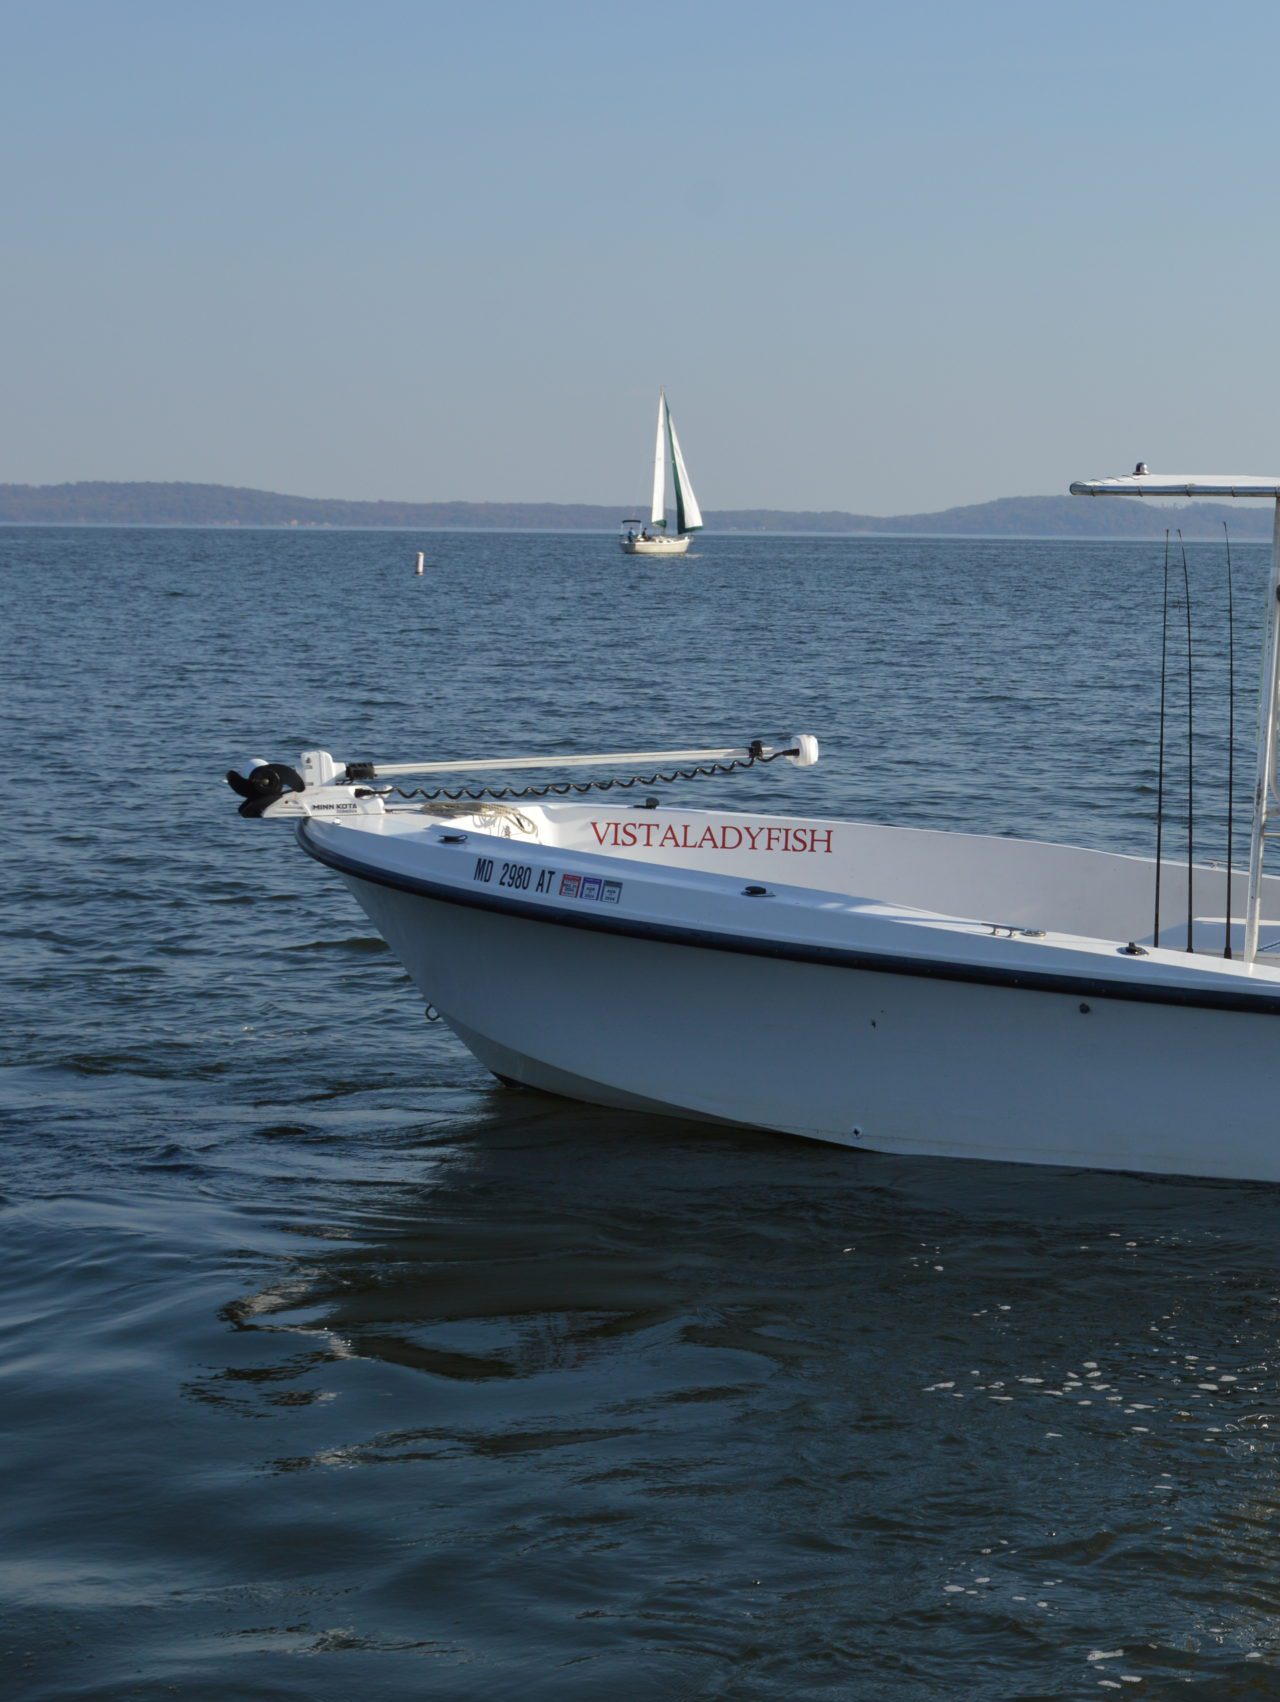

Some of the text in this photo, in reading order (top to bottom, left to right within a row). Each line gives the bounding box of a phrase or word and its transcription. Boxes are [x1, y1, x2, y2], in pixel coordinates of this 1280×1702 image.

[590, 821, 834, 853] VISTALADYFISH
[473, 858, 494, 883] MD
[499, 862, 532, 890] 2980
[535, 869, 556, 894] AT
